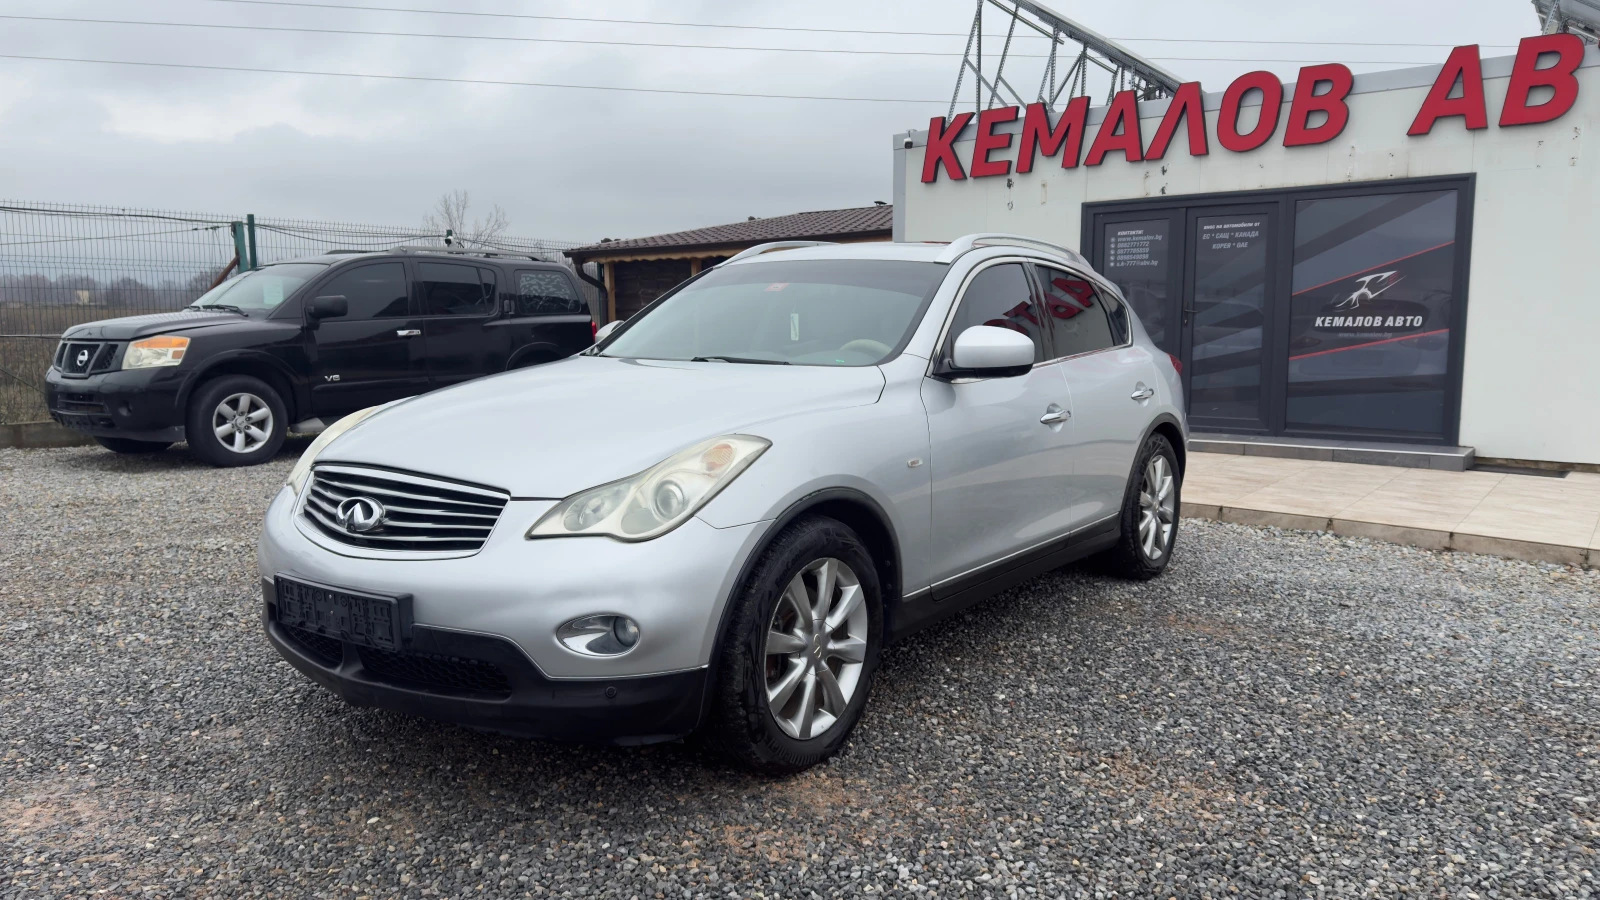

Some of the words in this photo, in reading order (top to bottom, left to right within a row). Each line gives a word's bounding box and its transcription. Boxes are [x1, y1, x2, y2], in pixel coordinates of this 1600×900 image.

[921, 62, 1354, 184] КЕМАЛОВ
[1406, 32, 1600, 138] АВ
[1234, 230, 1258, 238] КАНАДА
[1315, 316, 1383, 327] КЕМАЛОВ
[1384, 315, 1423, 327] АВТО
[324, 374, 340, 382] V6
